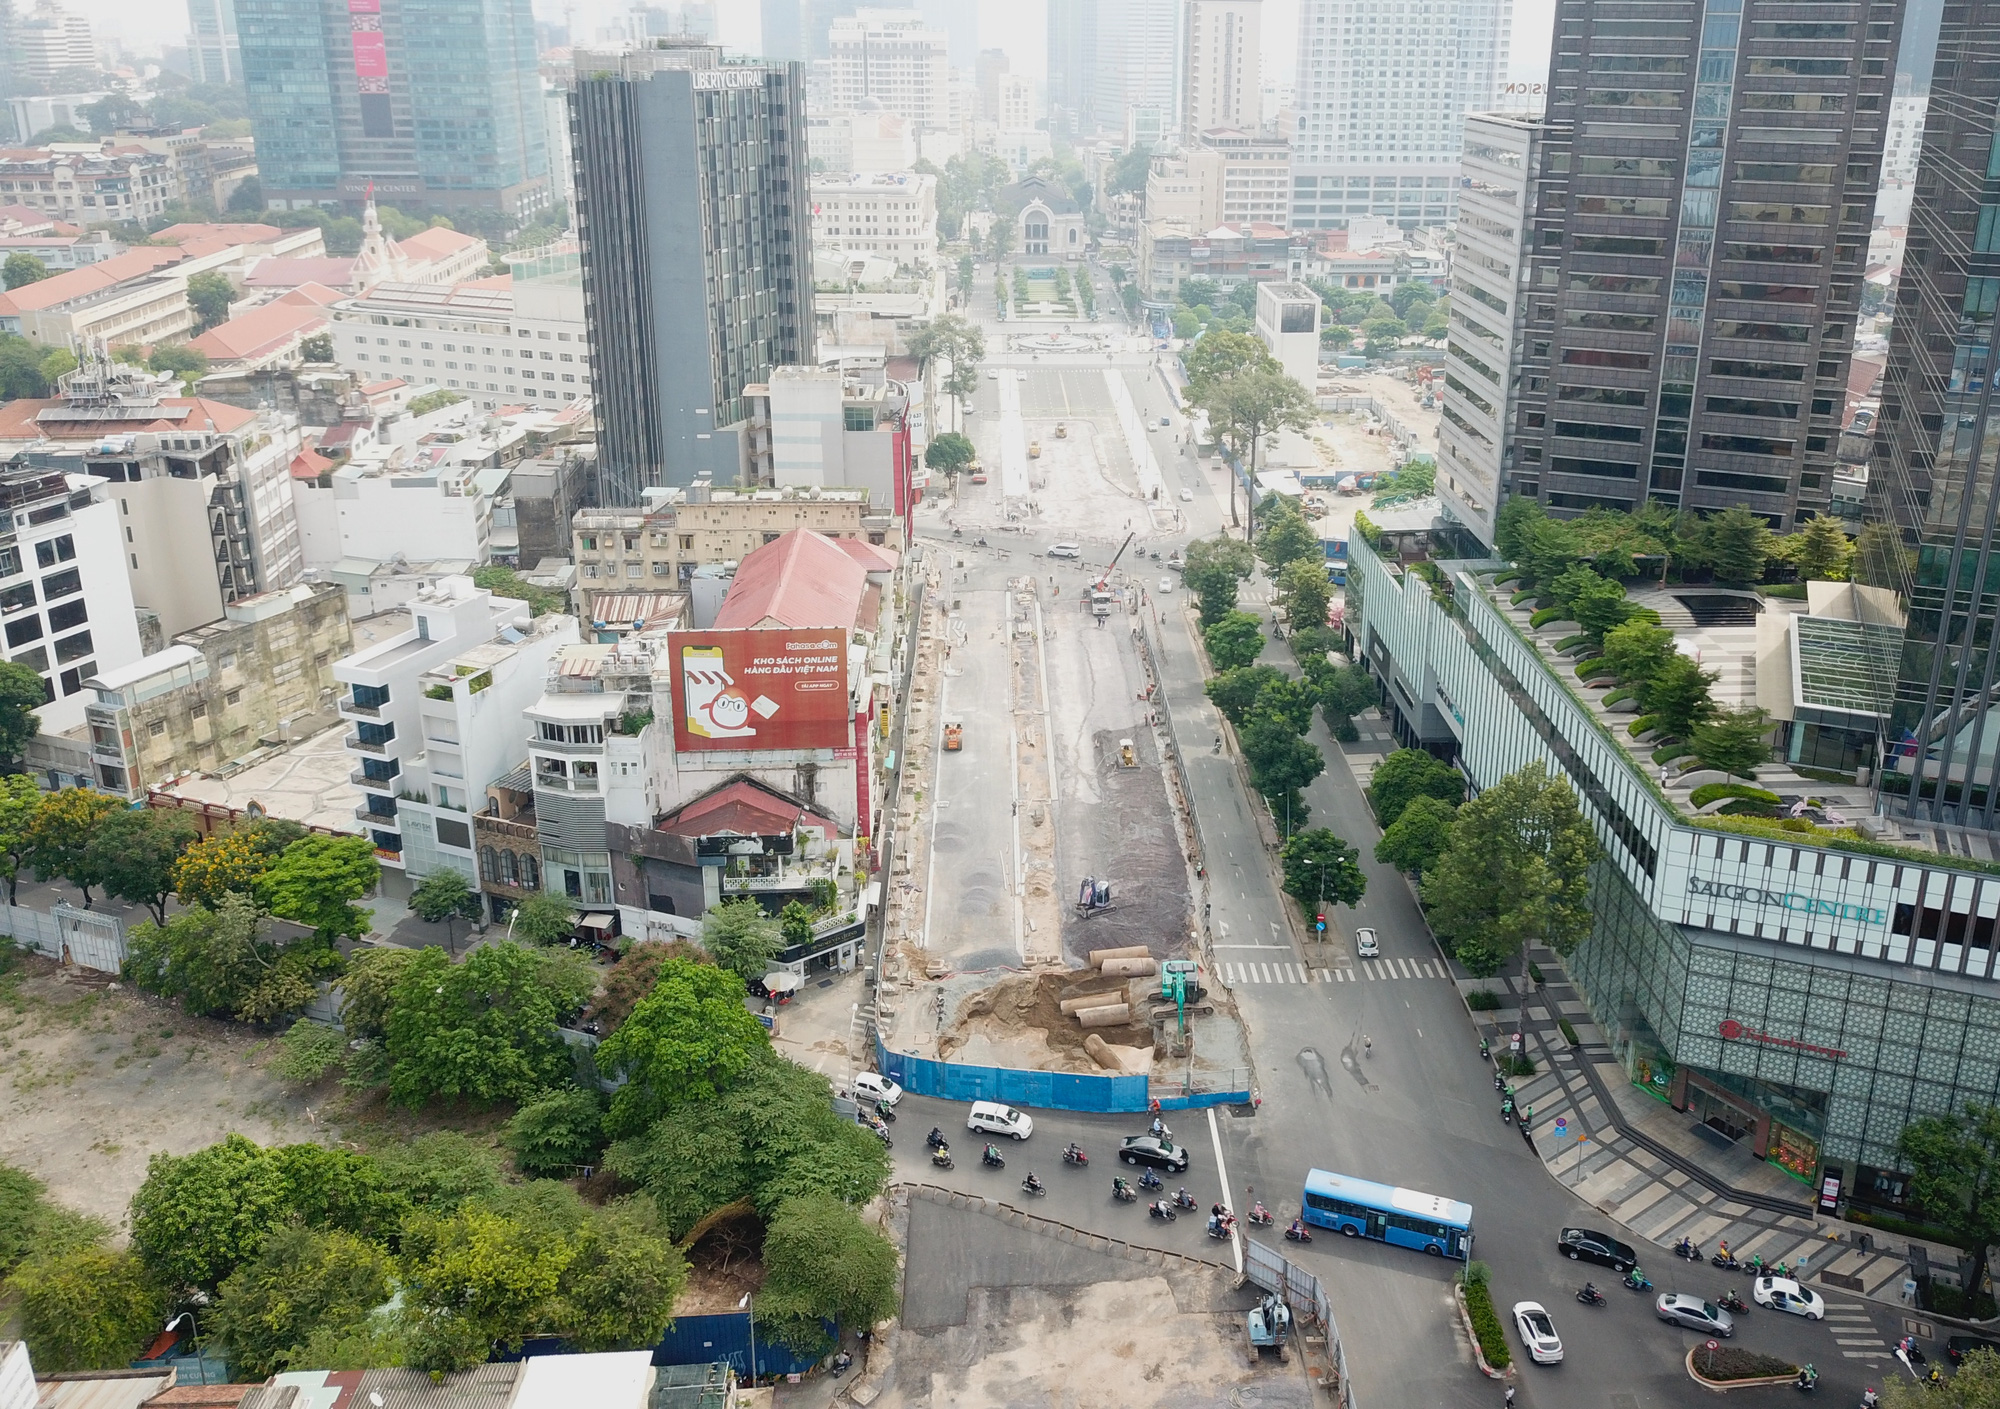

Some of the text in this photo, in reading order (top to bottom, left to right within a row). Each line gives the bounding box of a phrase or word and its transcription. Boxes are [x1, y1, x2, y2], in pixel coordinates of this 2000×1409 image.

[692, 70, 763, 89] LIBERTY CENTRAL
[753, 656, 838, 665] KHO SÁCH ONLINE
[744, 664, 838, 675] HÀNG ĐẦU VIỆT NAM
